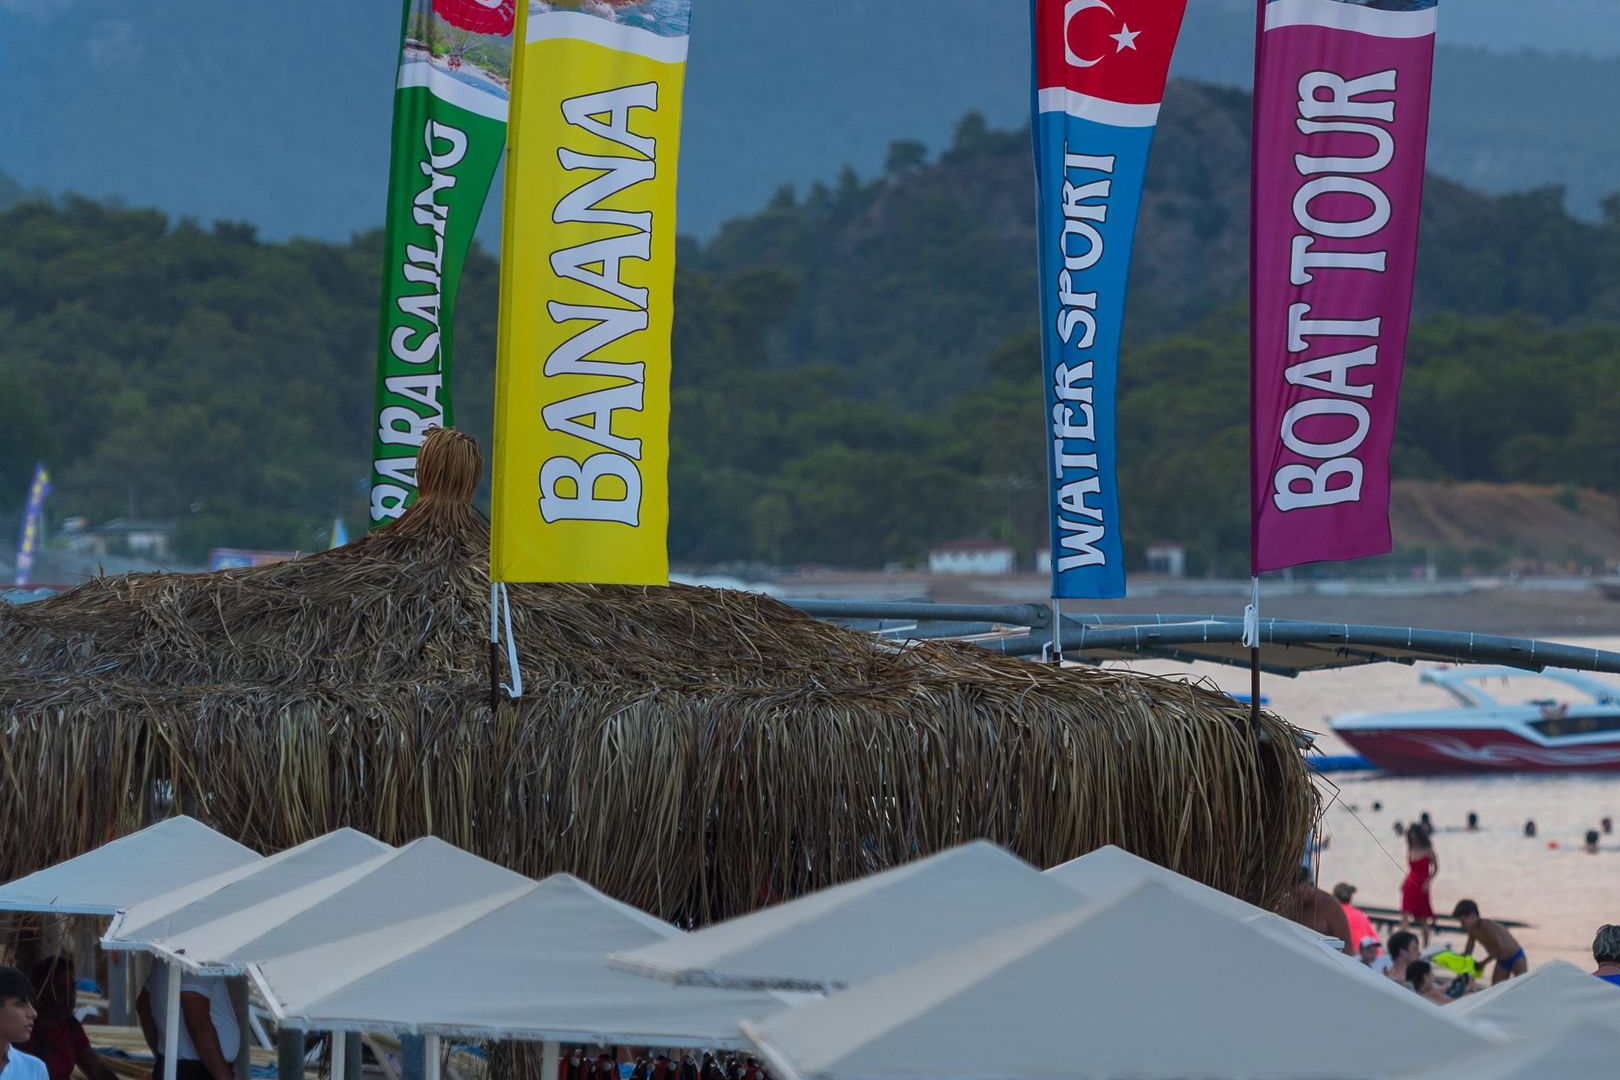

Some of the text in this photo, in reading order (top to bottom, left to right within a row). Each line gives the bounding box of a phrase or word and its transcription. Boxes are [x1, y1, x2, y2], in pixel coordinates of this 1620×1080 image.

[538, 81, 658, 527] BANANA
[1053, 138, 1116, 573] WATER SPORT
[1273, 68, 1399, 512] BOAT TOUR
